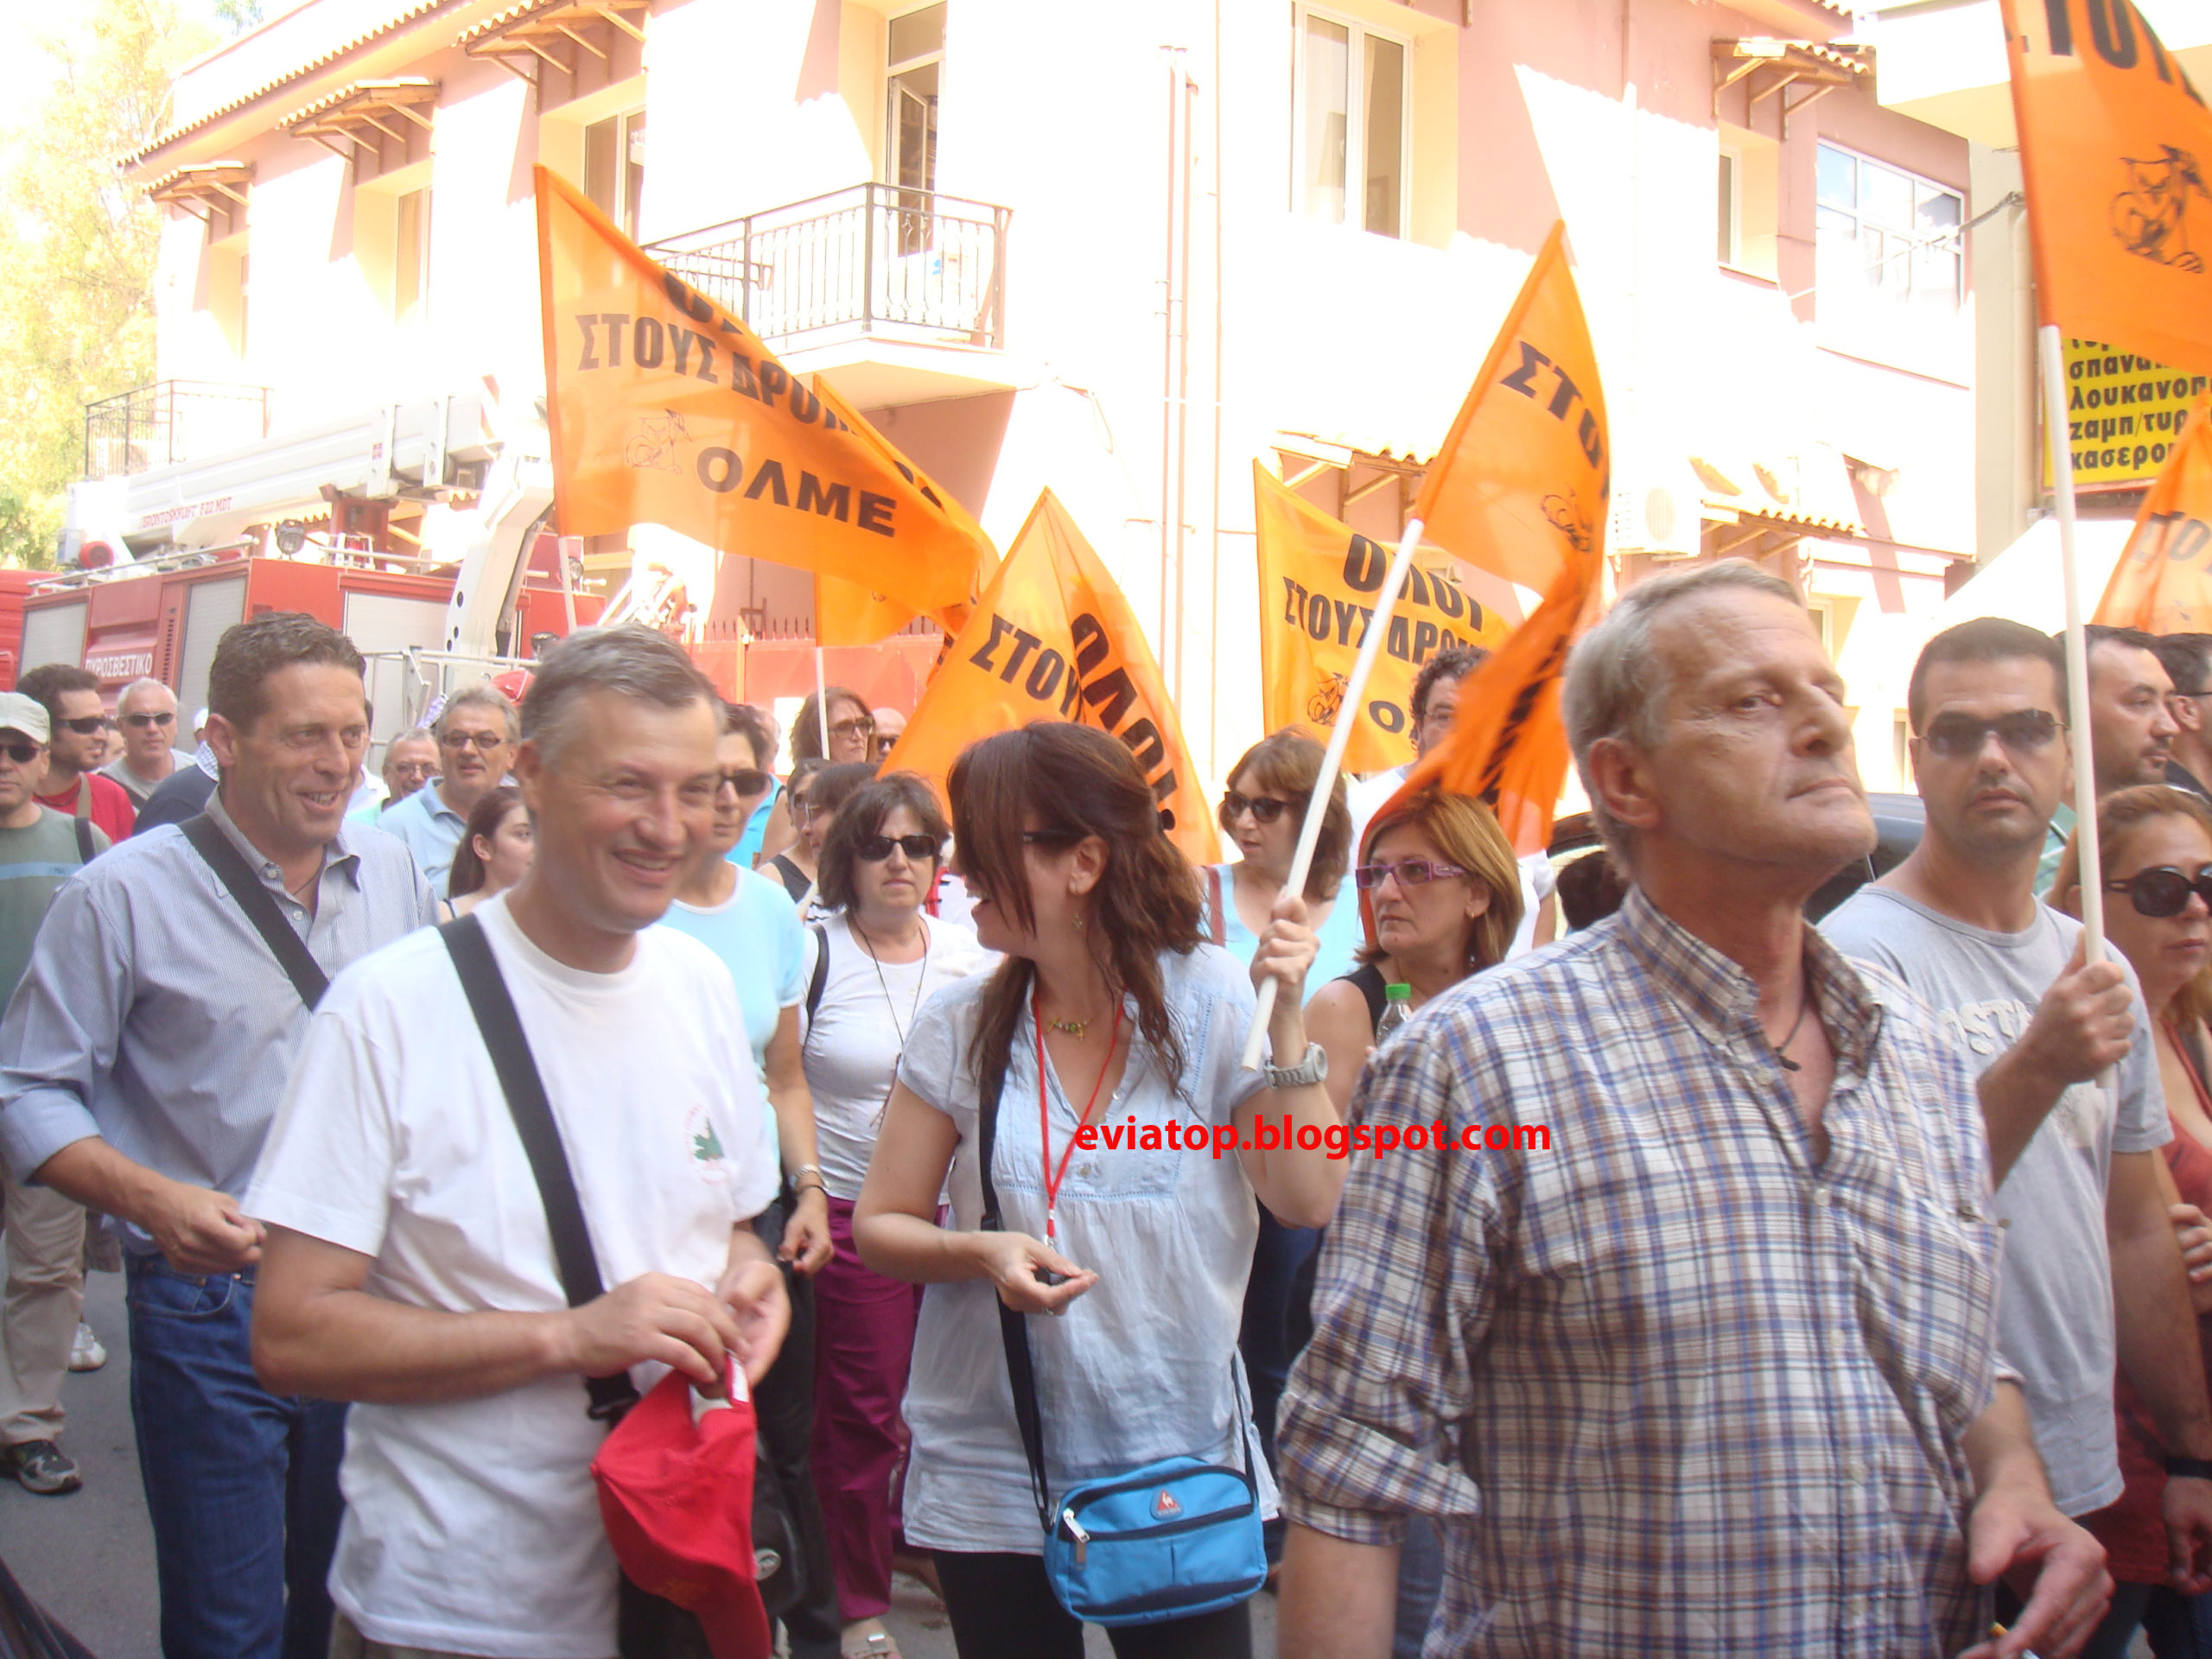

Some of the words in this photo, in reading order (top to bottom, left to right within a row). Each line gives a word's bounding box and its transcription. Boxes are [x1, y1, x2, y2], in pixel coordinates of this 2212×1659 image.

[575, 313, 719, 385] ΣΤΟΥΣ
[2069, 353, 2171, 380] σπανα
[1499, 340, 1610, 500] ΣΤΟ
[2069, 375, 2212, 411] λουκανοπ
[696, 447, 897, 538] ΟΛΜΕ
[1387, 614, 1481, 666] ΔΡΟ
